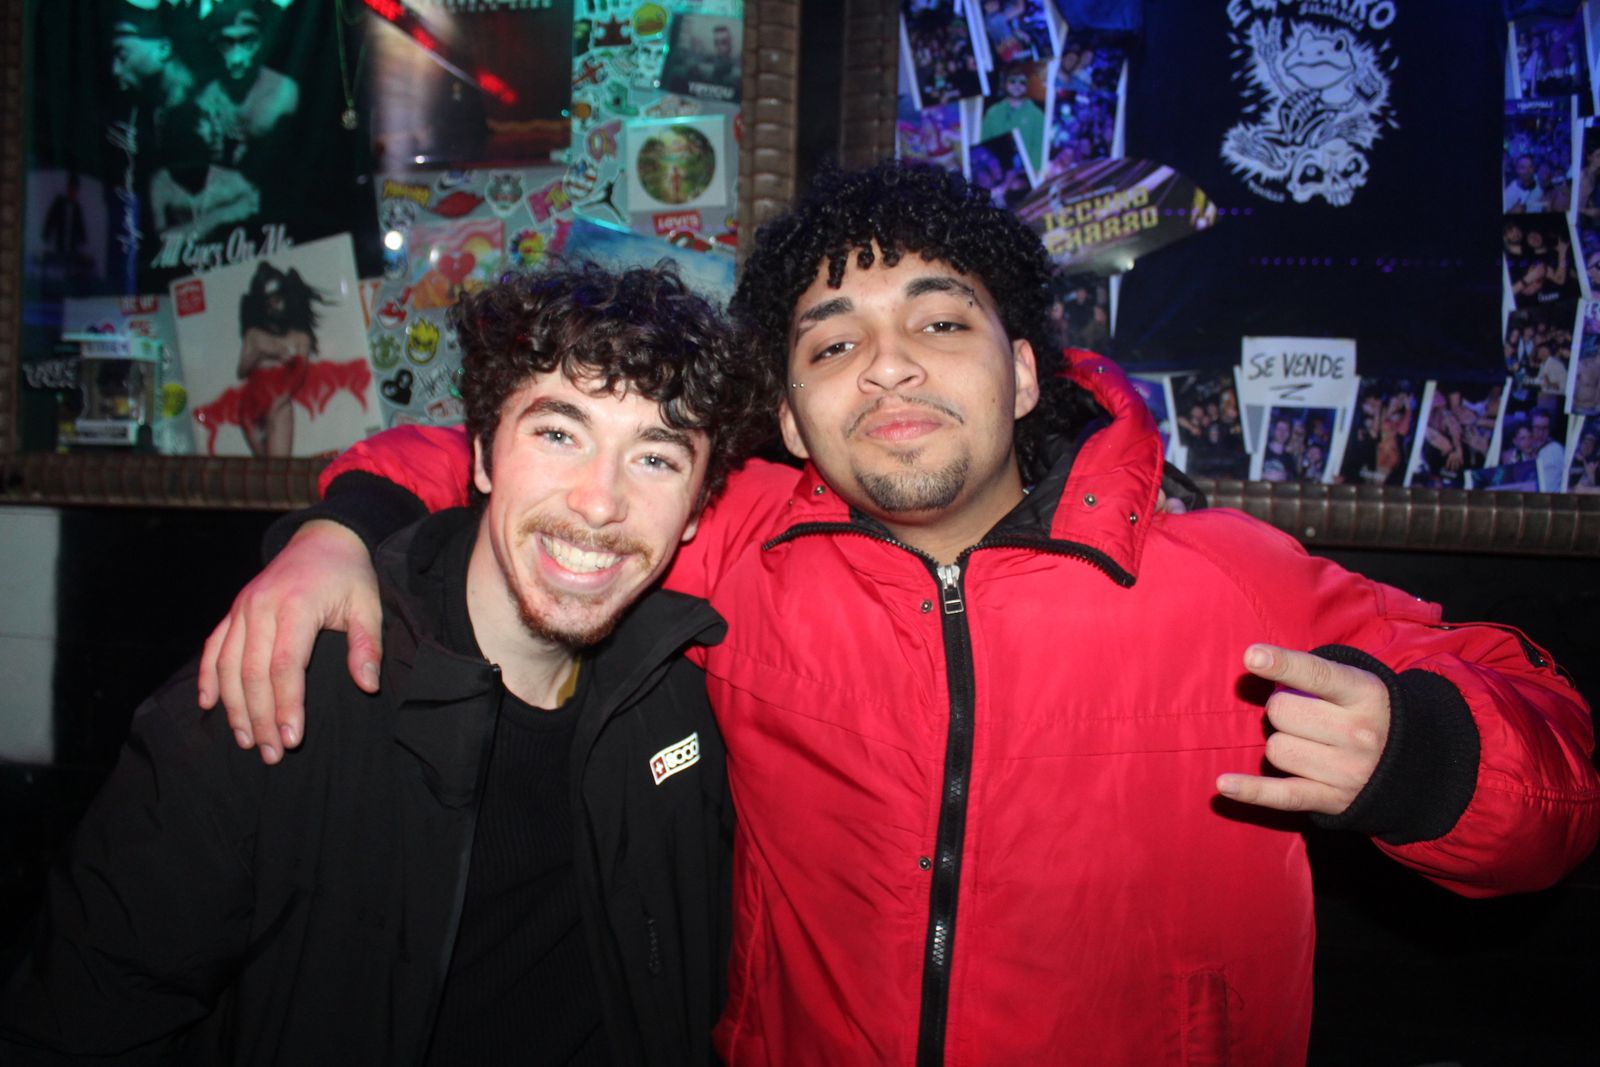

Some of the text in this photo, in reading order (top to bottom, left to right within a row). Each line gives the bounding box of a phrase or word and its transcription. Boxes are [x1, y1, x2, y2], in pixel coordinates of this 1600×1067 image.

[1043, 186, 1150, 232] TECHNO
[1045, 205, 1160, 256] CHARRO
[1248, 352, 1345, 380] SE VENDE
